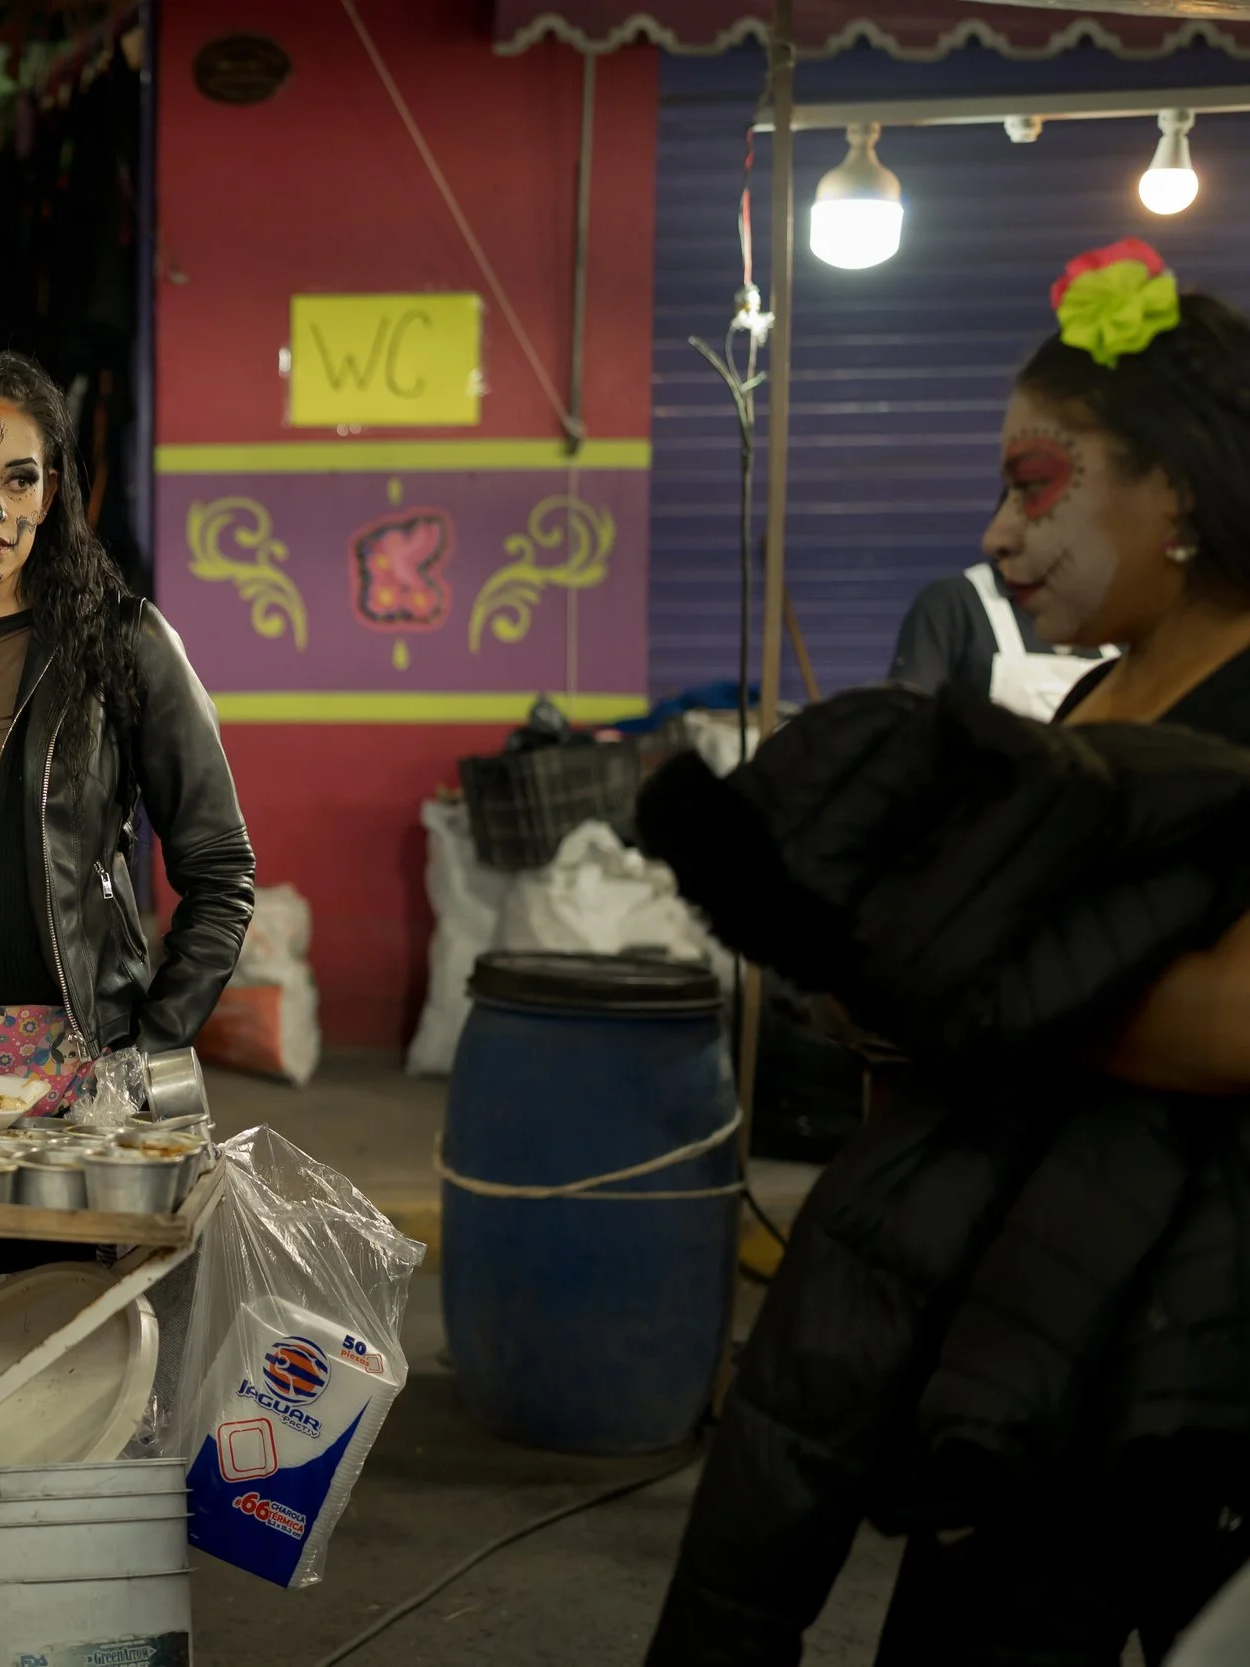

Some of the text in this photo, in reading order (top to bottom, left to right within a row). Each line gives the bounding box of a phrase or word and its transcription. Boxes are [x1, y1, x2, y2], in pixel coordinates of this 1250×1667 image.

[310, 306, 433, 401] WC
[342, 1334, 367, 1356] 50
[341, 1349, 370, 1367] piezas
[237, 1378, 320, 1431] JAGUAR
[283, 1415, 317, 1436] PACTIV
[234, 1492, 270, 1521] #66
[271, 1503, 305, 1523] CHAROLA
[269, 1511, 304, 1533] TÉRMICA
[94, 1646, 149, 1665] GreenArrow
